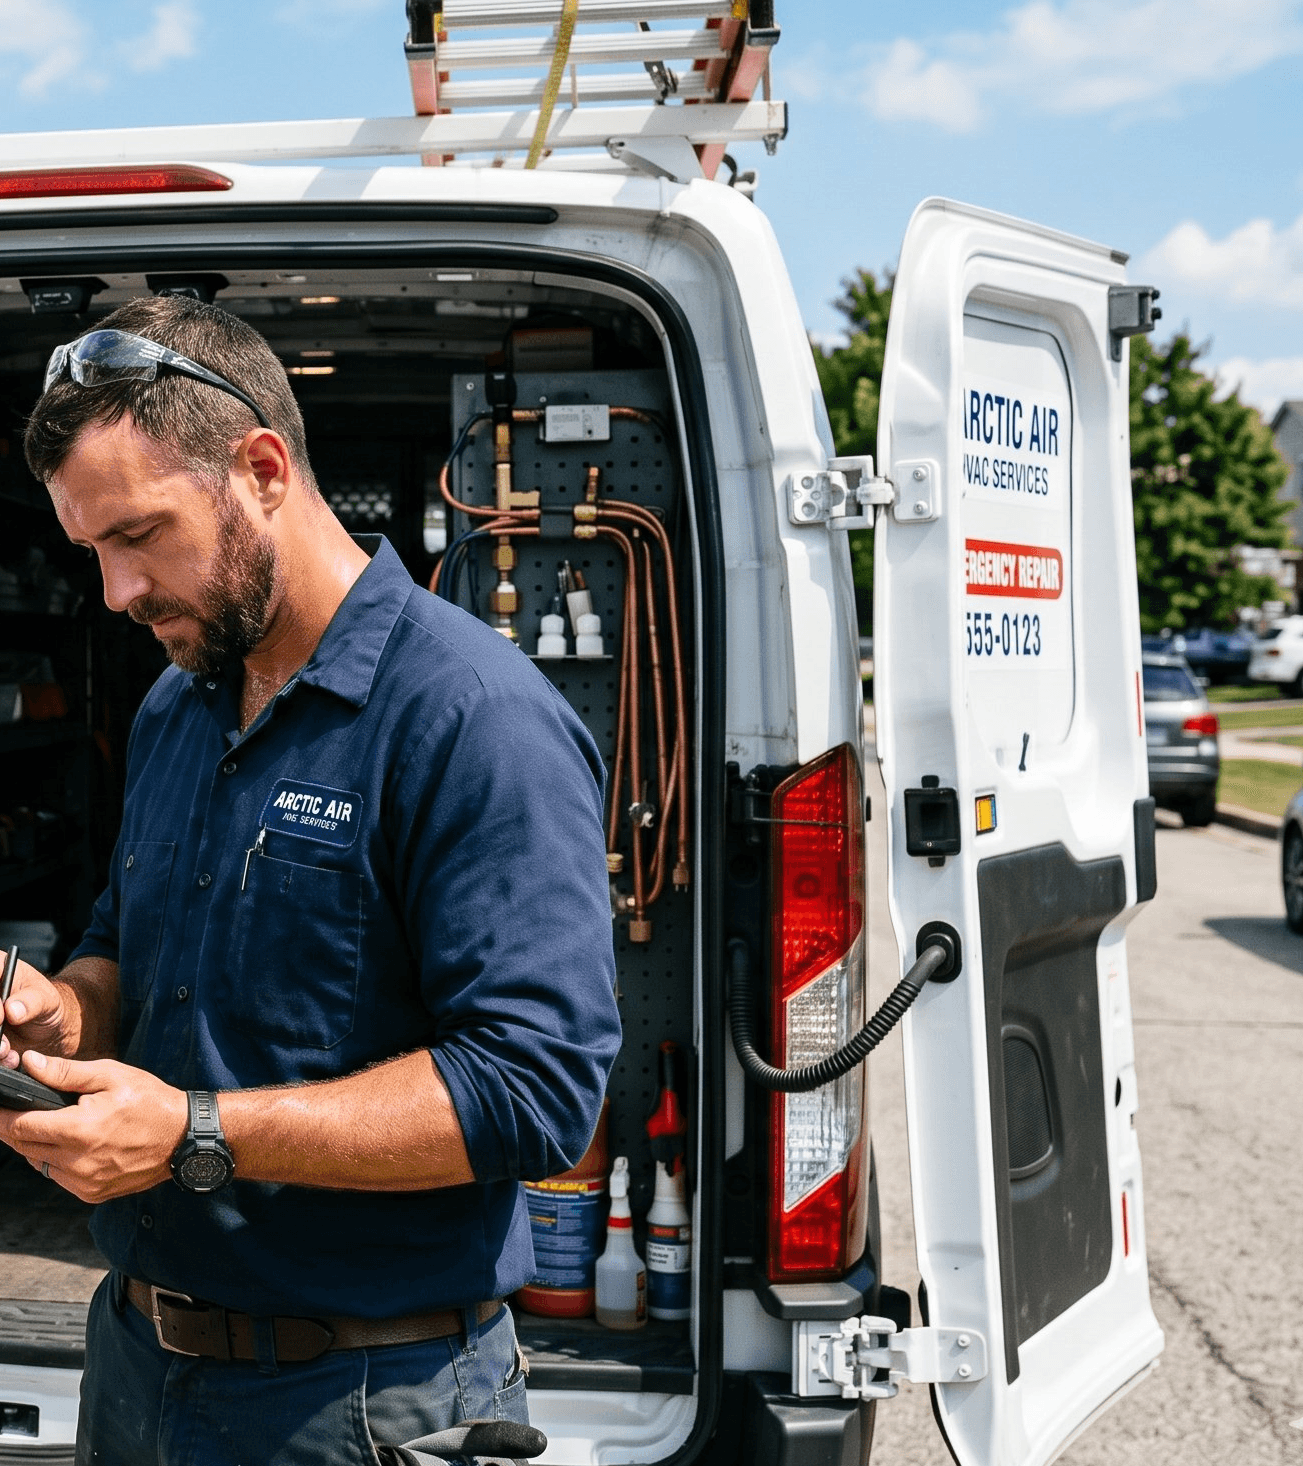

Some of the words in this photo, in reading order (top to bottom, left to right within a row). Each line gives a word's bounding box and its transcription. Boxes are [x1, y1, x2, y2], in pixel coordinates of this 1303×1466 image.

[1029, 404, 1059, 457] AIR
[992, 458, 1049, 496] SERVICES
[1018, 555, 1060, 590] REPAIR
[274, 791, 322, 814] ARCTIC
[325, 800, 352, 822] AIR
[300, 815, 337, 830] SERVICES
